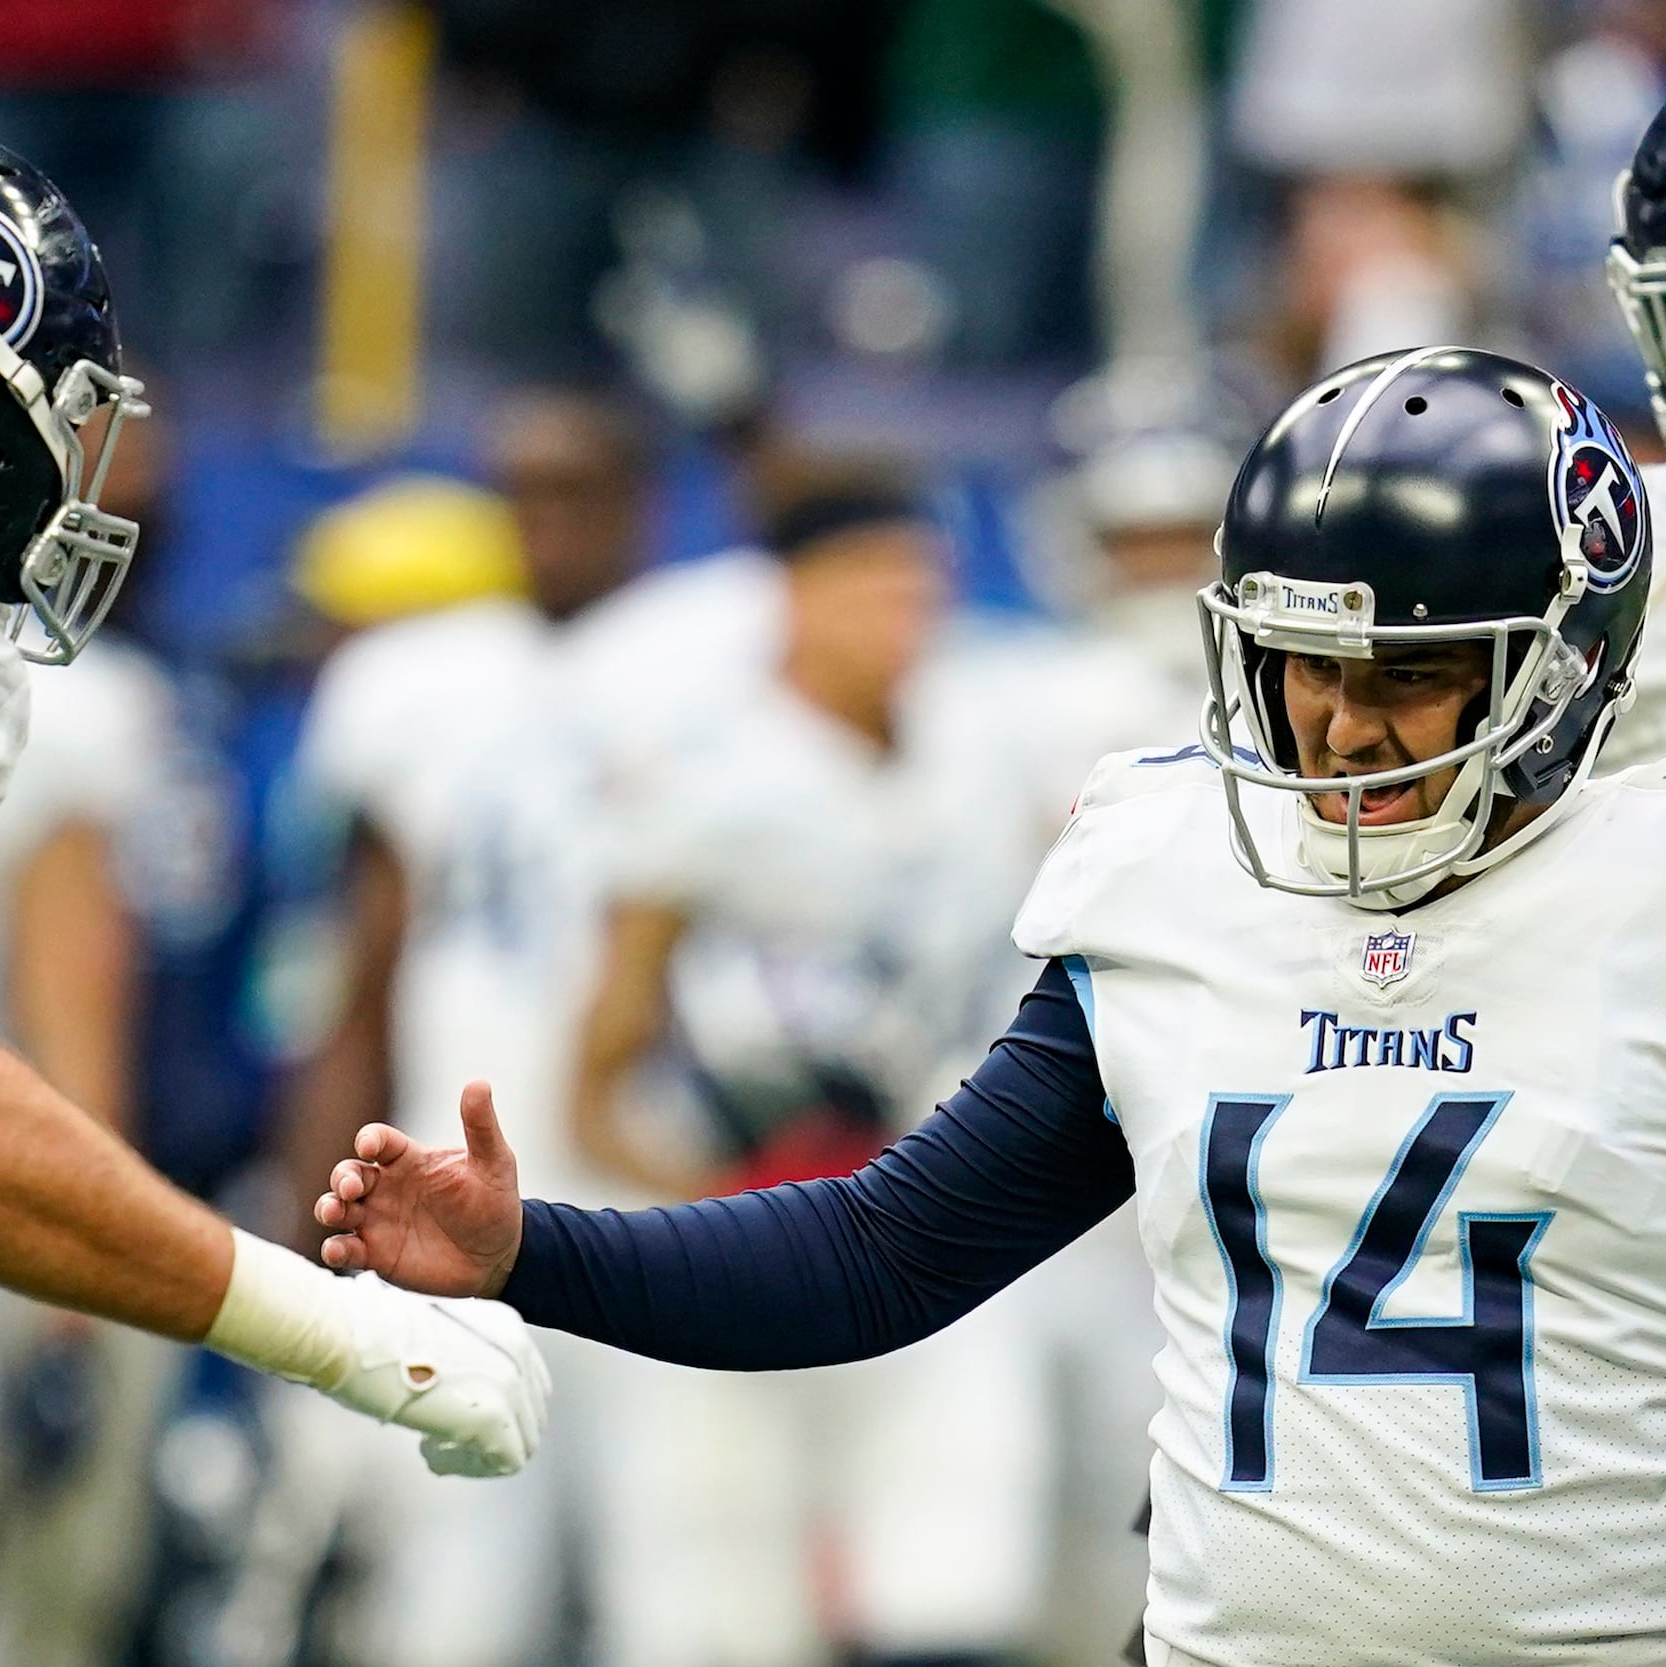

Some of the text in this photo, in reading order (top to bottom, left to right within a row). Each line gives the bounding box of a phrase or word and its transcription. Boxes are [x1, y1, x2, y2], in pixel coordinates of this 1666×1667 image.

[1283, 586, 1338, 614] TITANS
[1367, 952, 1403, 975] NFL
[1300, 1008, 1478, 1074] TITANS
[1198, 1090, 1557, 1493] 14
